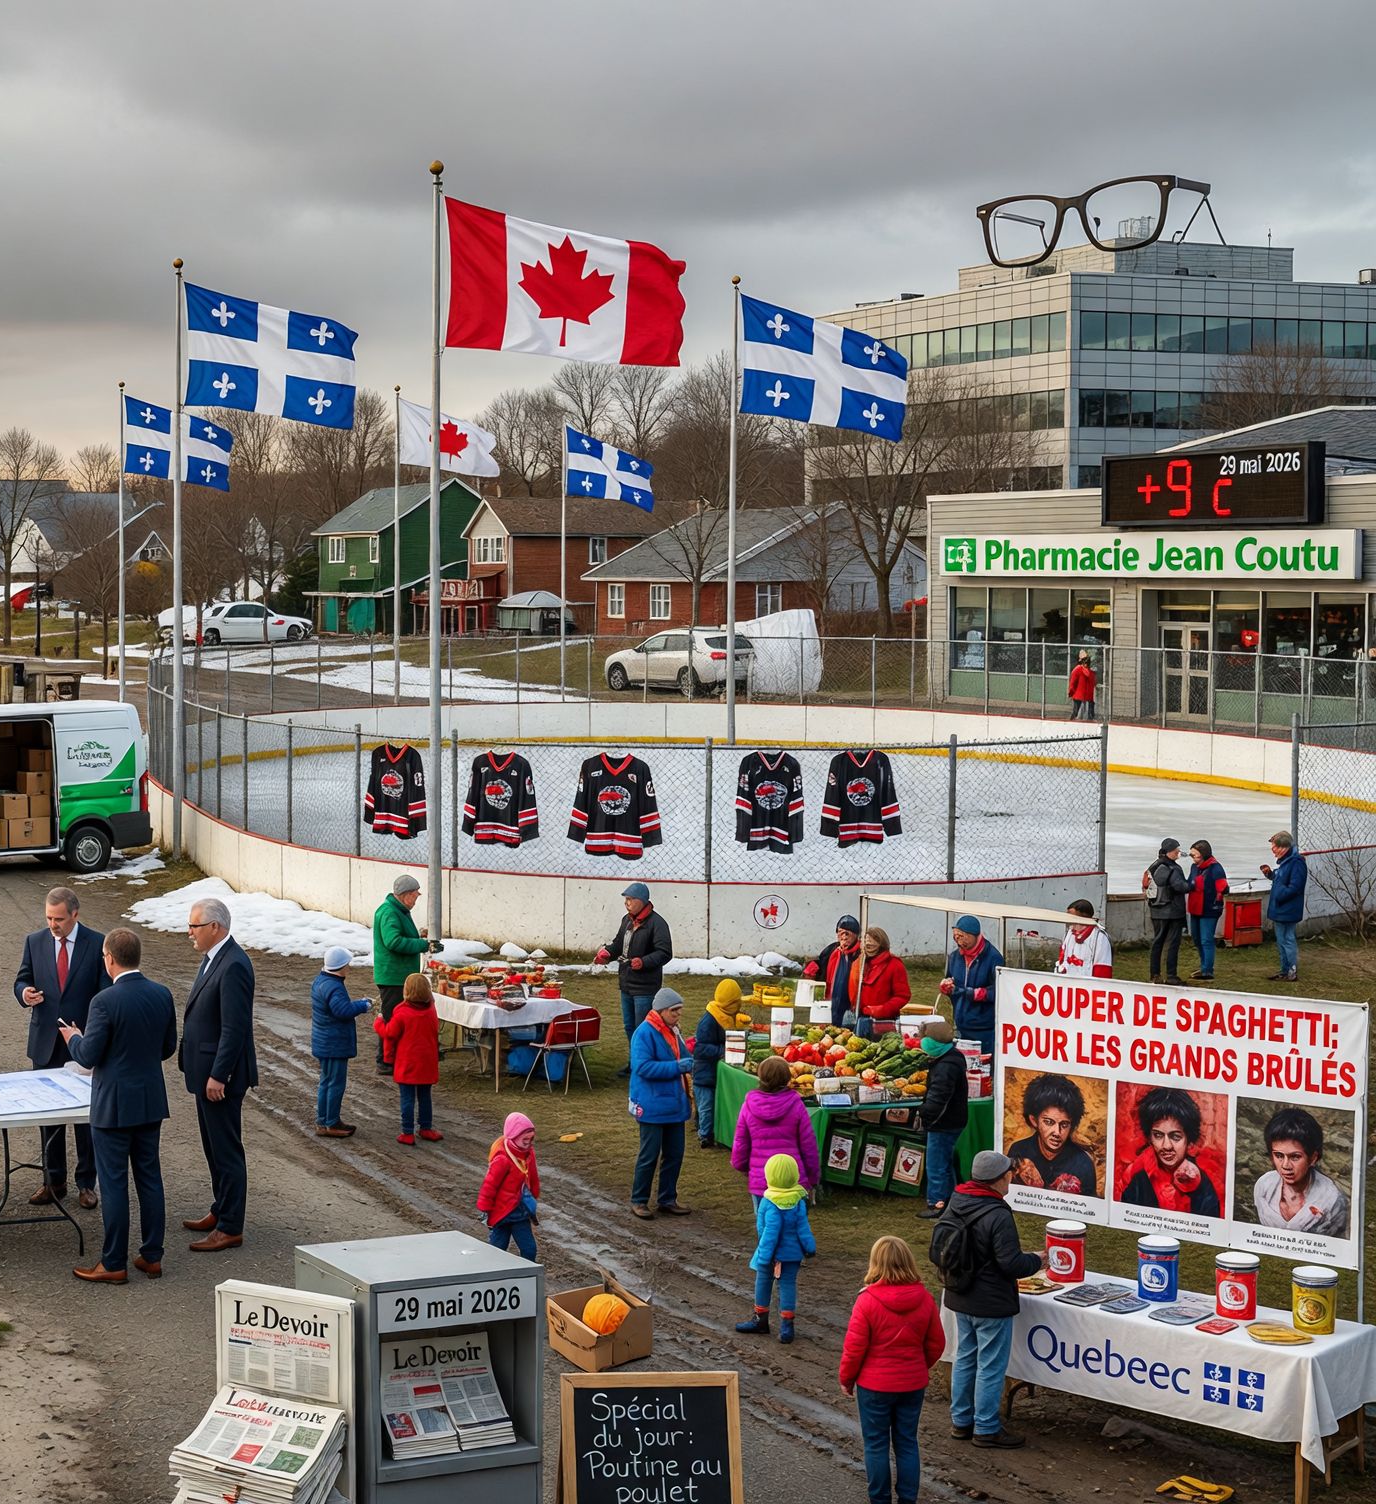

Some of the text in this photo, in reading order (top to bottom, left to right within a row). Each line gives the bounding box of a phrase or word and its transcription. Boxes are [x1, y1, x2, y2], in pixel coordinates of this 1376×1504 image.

[1219, 451, 1301, 475] 29 mai 2026
[985, 537, 1339, 572] Pharmacie Jean Coutu
[1022, 983, 1339, 1049] SOUPER DE SPAGHETTI:
[1002, 1023, 1356, 1098] POUR LES GRANDS BRÛLÉS
[234, 1300, 329, 1338] Le Devoir
[394, 1286, 521, 1322] 29 mai 2026
[393, 1341, 482, 1370] Le Devoir
[1027, 1324, 1191, 1395] Quebeec
[591, 1392, 686, 1430] Spécial
[593, 1424, 622, 1447] du
[583, 1451, 722, 1479] Poutine au
[616, 1477, 699, 1504] poulet
